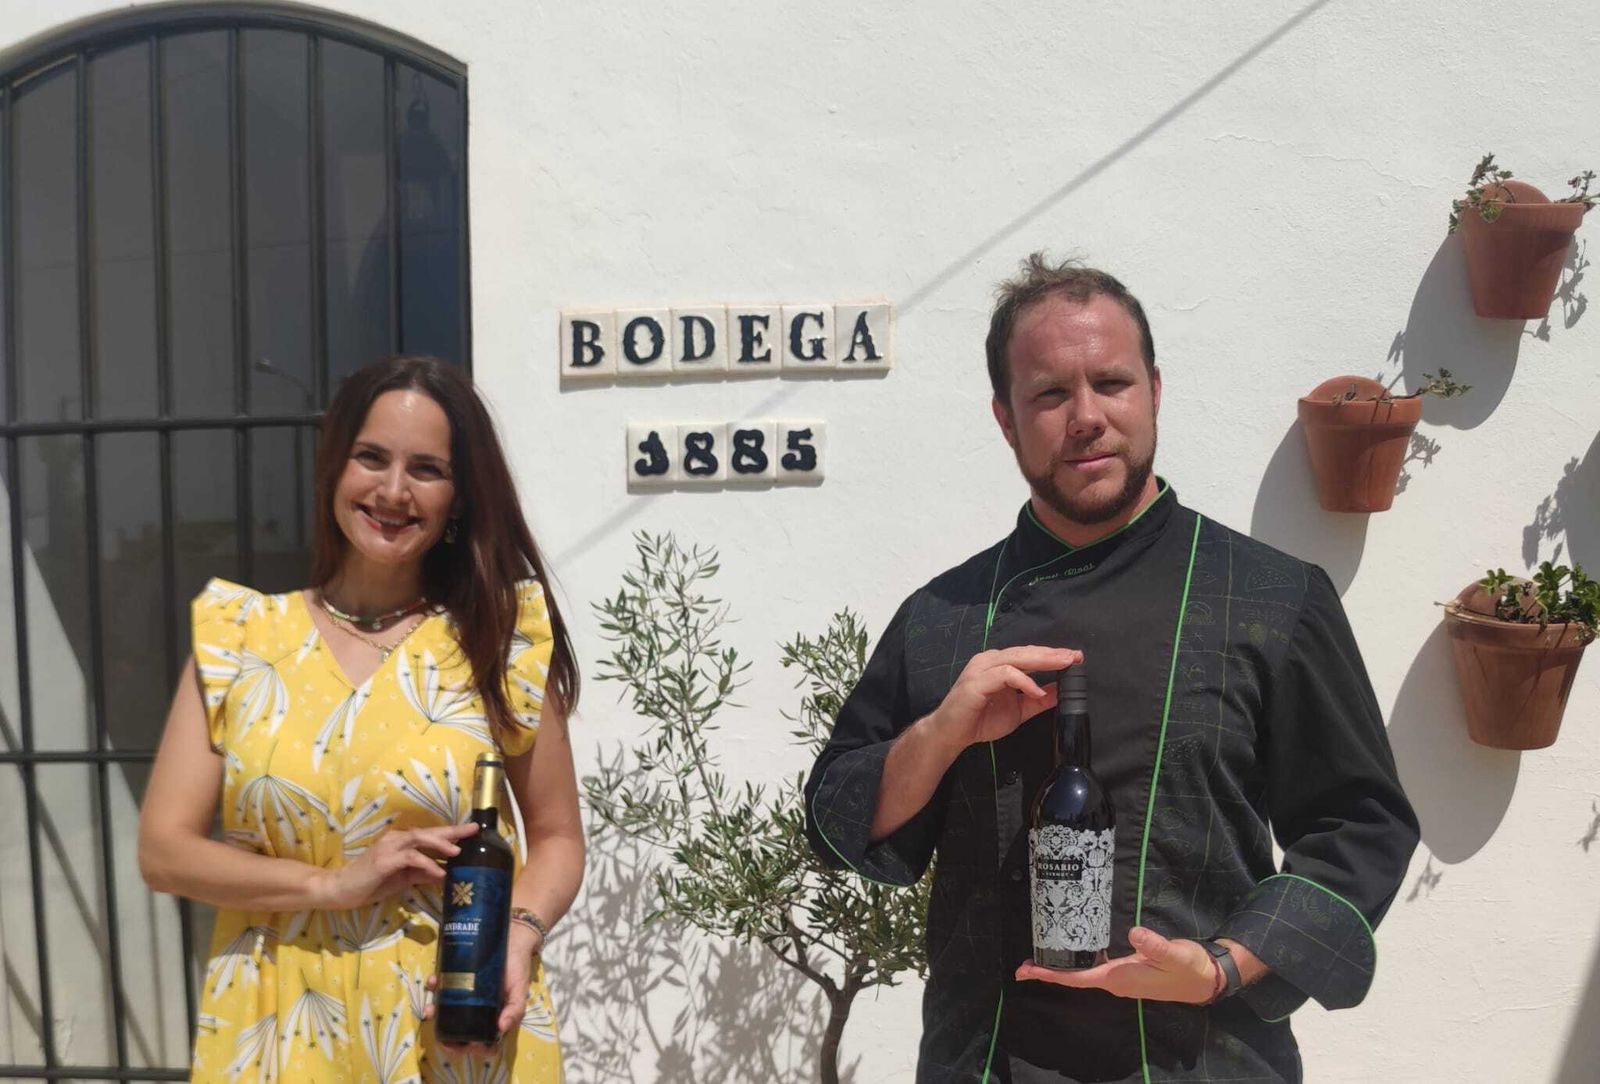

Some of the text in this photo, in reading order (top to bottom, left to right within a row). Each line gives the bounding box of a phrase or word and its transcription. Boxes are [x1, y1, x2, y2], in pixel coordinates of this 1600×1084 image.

[571, 311, 882, 367] BODEGA
[635, 428, 817, 476] 1885
[1037, 863, 1080, 871] ROSARIO
[444, 922, 480, 931] ANDRADE
